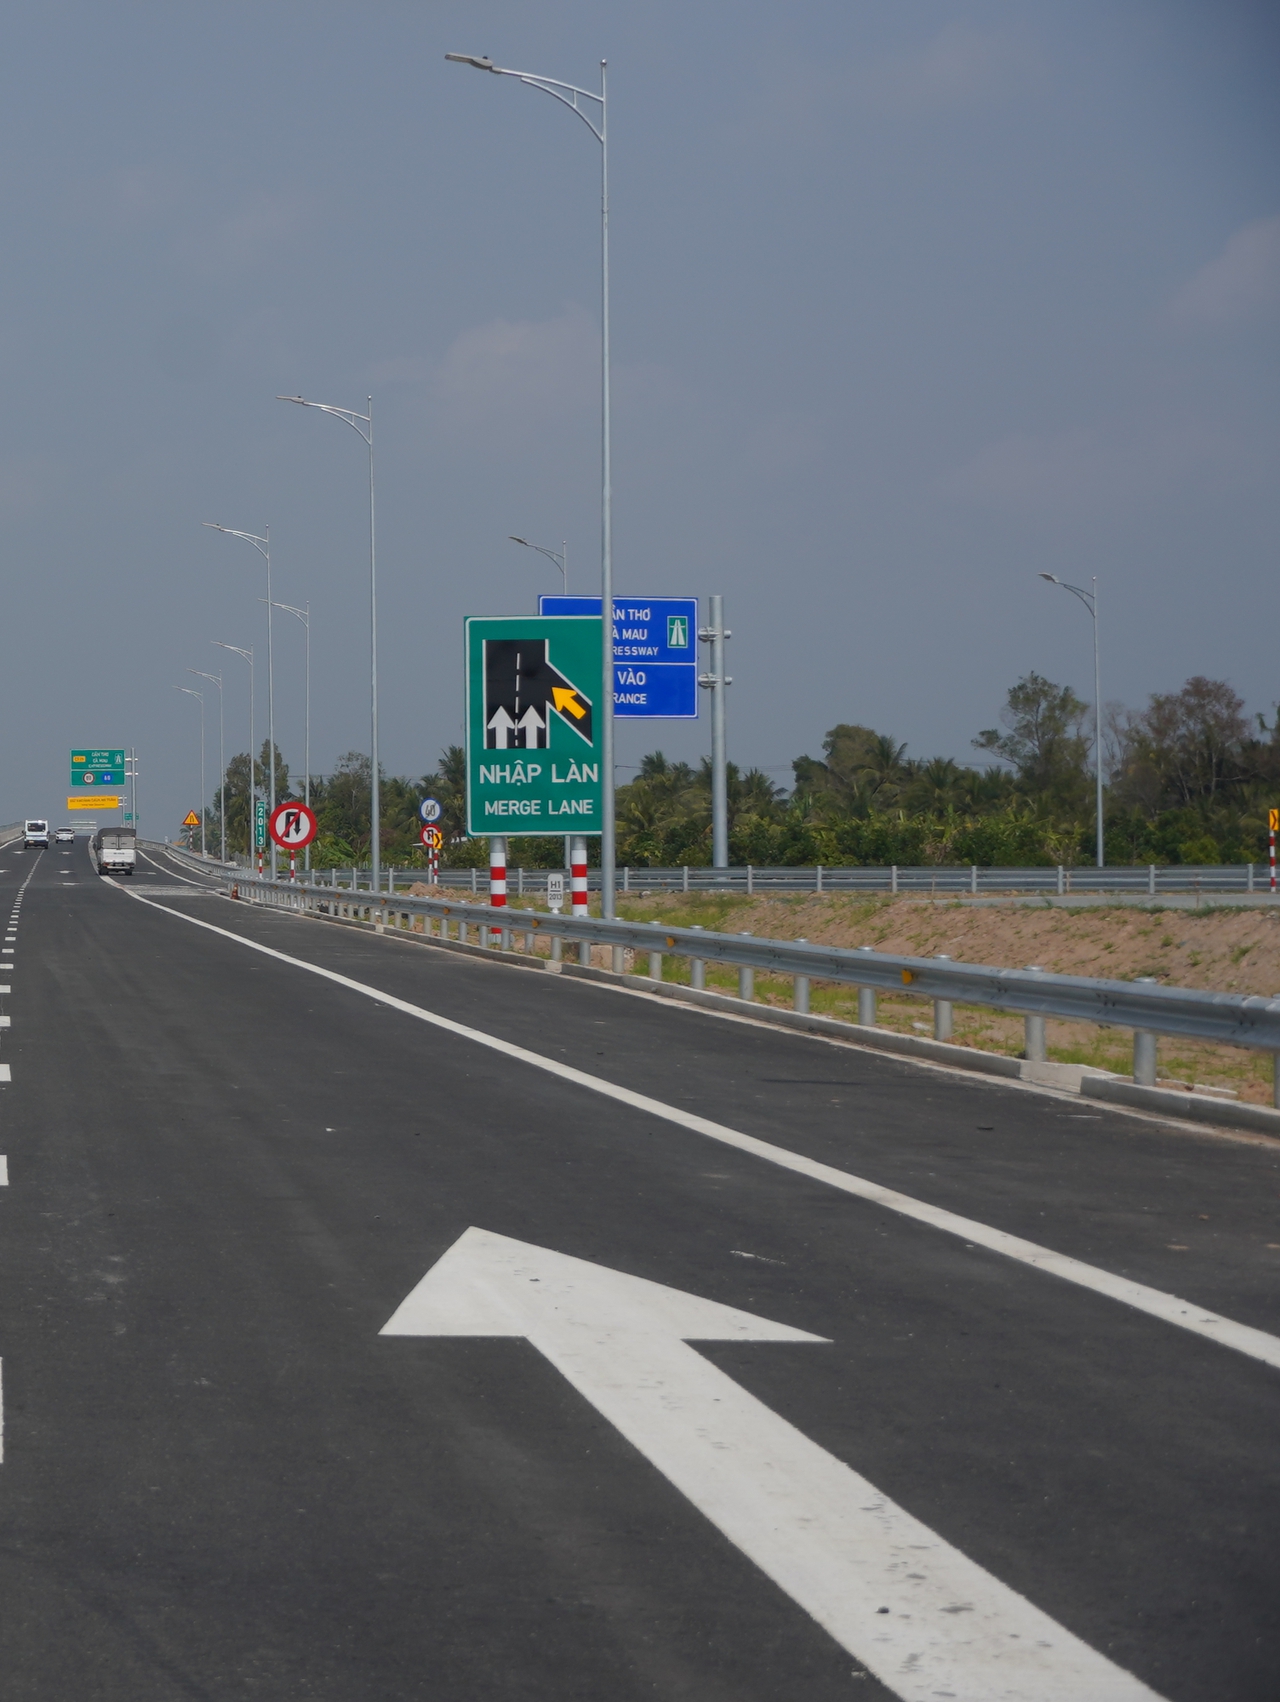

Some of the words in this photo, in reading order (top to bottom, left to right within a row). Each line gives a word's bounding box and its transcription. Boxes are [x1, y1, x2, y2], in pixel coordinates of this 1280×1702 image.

[628, 607, 651, 621] THƠ
[622, 628, 648, 640] MAU
[612, 646, 659, 656] RESSWAY
[617, 667, 646, 686] VÀO
[612, 693, 647, 704] RANCE
[479, 759, 542, 786] NHẬP
[551, 758, 599, 783] LÀN
[484, 800, 541, 816] MERGE
[548, 799, 594, 815] LANE
[550, 881, 561, 889] H1
[549, 893, 562, 901] 2013
